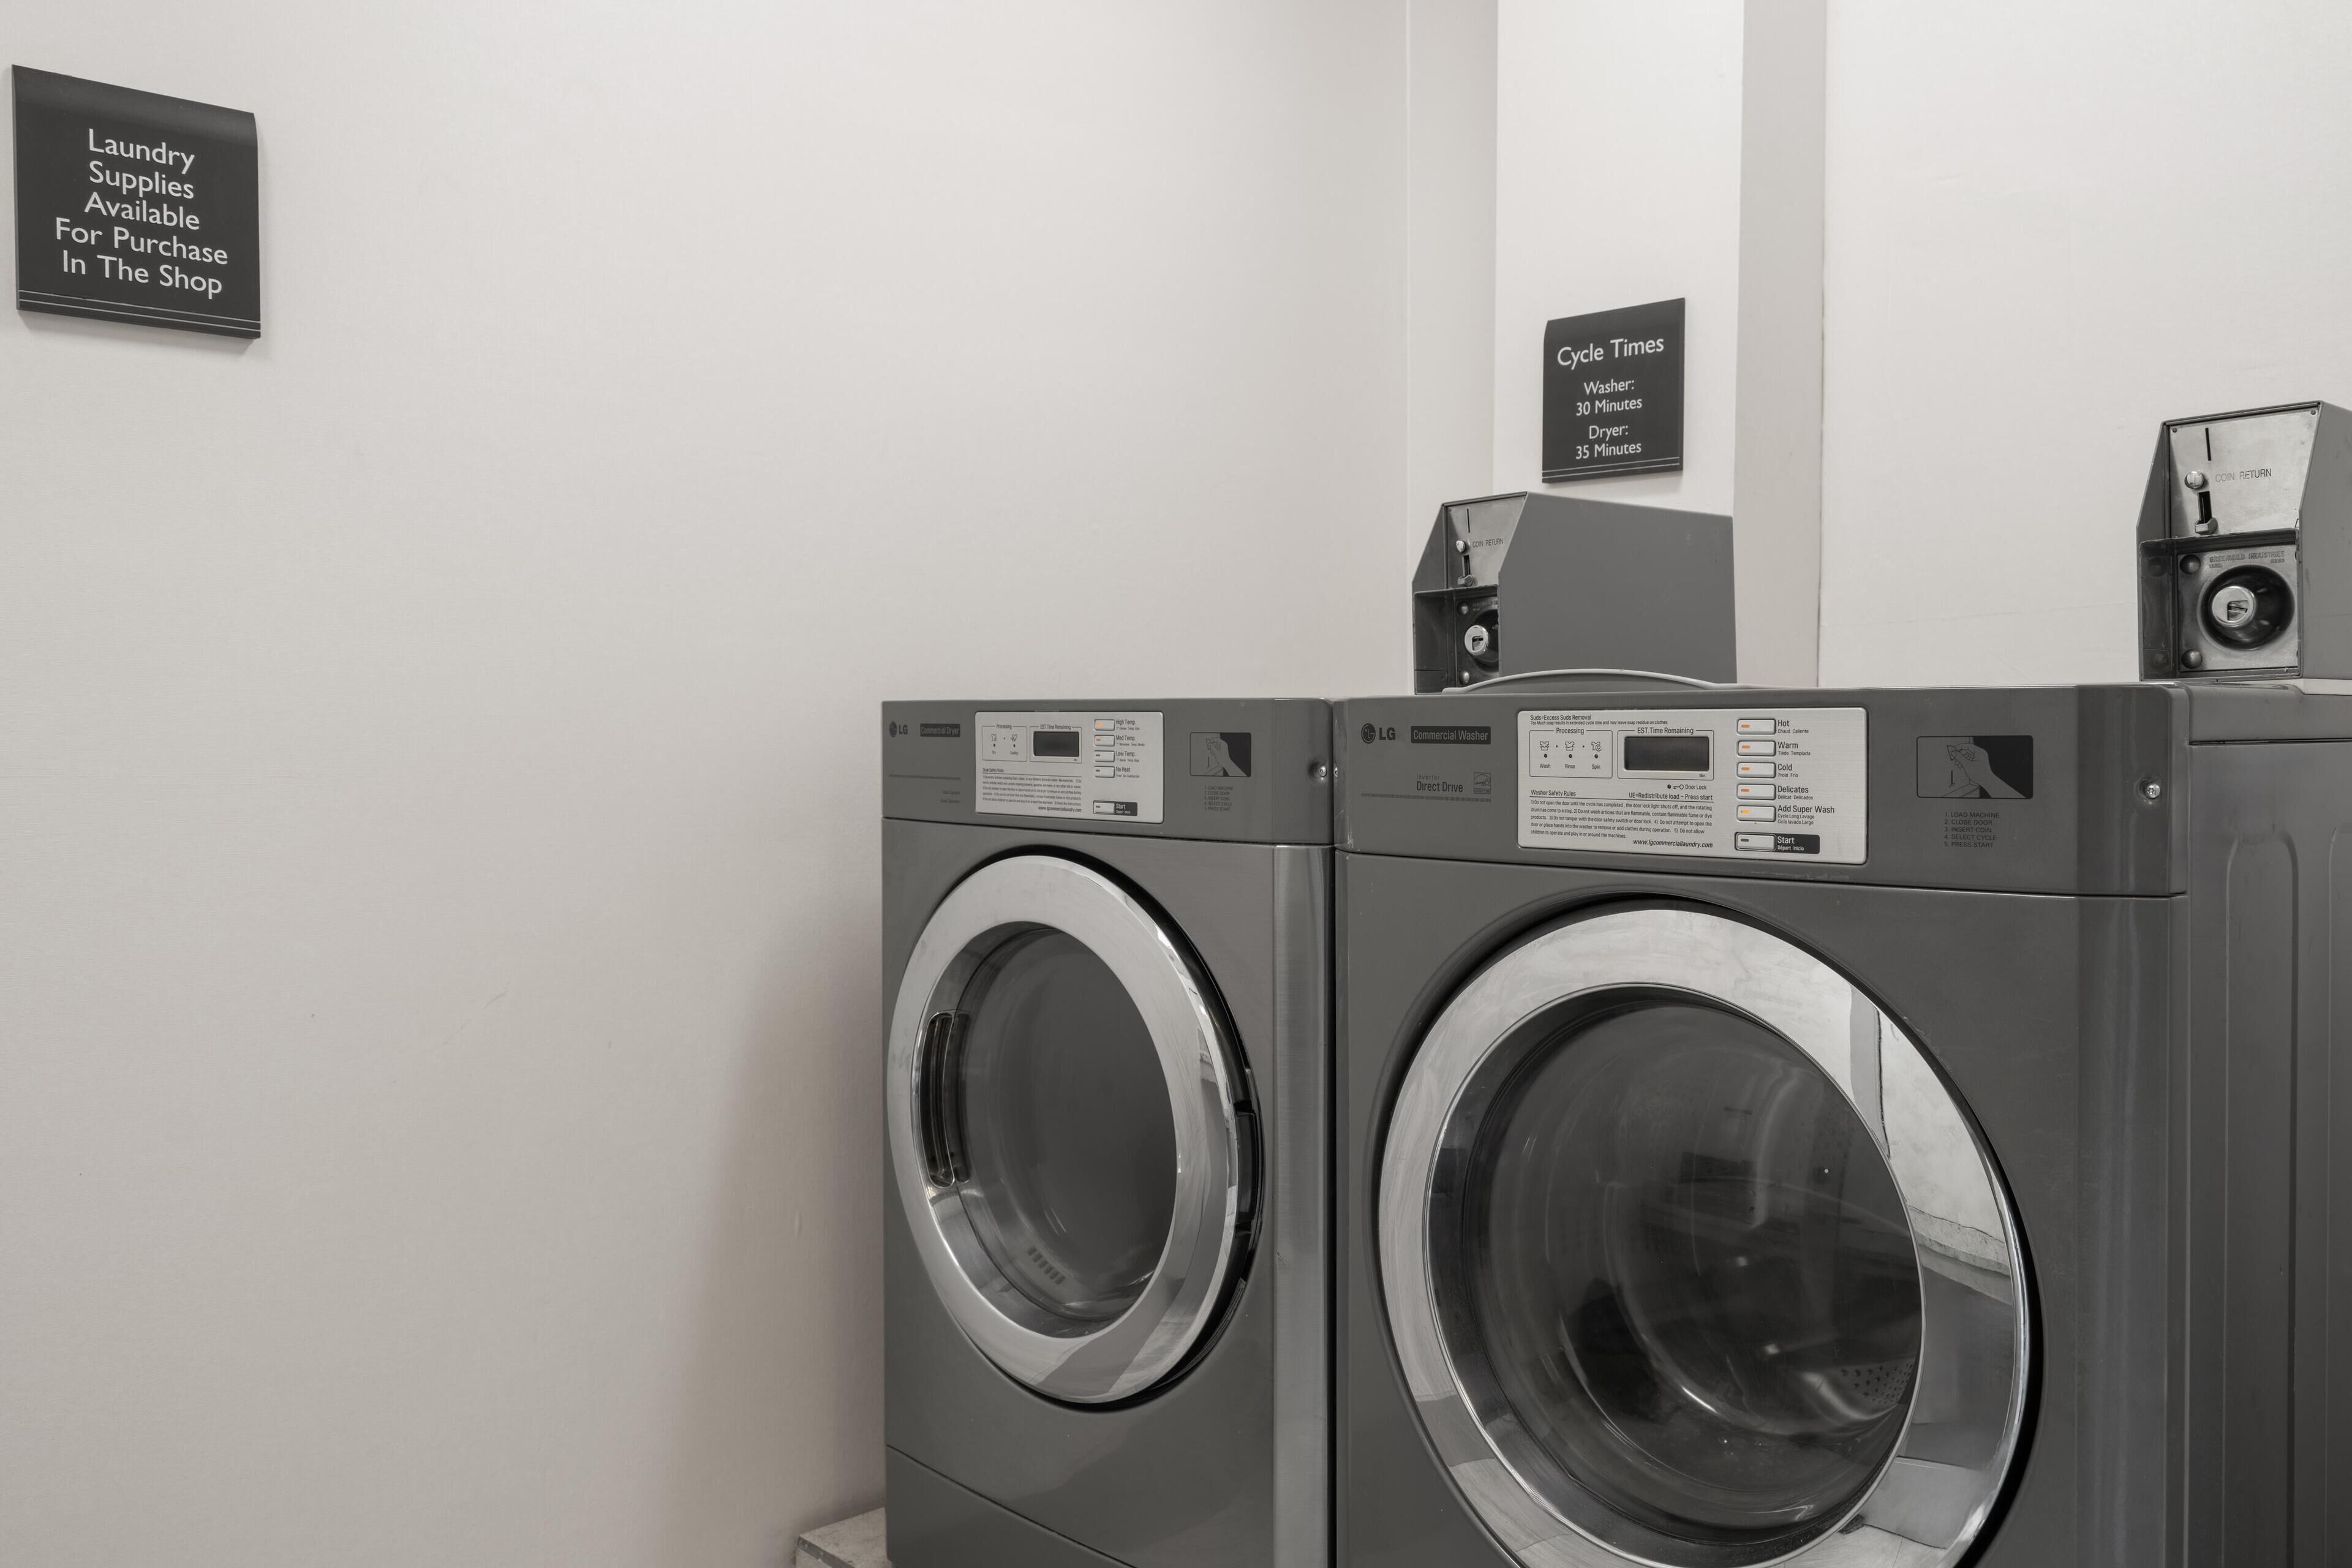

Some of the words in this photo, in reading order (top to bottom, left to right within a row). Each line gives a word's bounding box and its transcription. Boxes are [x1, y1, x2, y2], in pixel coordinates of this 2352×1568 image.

[89, 129, 195, 175] Laundry
[89, 160, 194, 199] Supplies
[84, 192, 199, 230] Available
[56, 217, 103, 245] For
[114, 226, 227, 265] Purchase
[63, 250, 85, 274] In
[97, 255, 148, 283] The
[160, 265, 222, 300] Shop
[1558, 343, 1604, 370] Cycle
[1610, 339, 1664, 358] Times
[1584, 379, 1634, 395] Washer:
[1577, 401, 1590, 416] 30
[1596, 399, 1642, 413] Minutes
[1589, 426, 1628, 441] Dryer:
[1576, 445, 1589, 459] 35
[1594, 443, 1642, 457] Minutes
[2215, 473, 2234, 482] COIN
[2240, 469, 2271, 480] RETURN
[899, 725, 908, 734] LG
[1379, 727, 1396, 741] LG
[1414, 730, 1456, 740] Commercial
[1458, 730, 1488, 740] Washer
[1417, 781, 1440, 791] Direct
[1442, 782, 1463, 793] Drive
[1793, 805, 1813, 814] Super
[1634, 840, 1713, 848] www.lgcommerciallaundry.com
